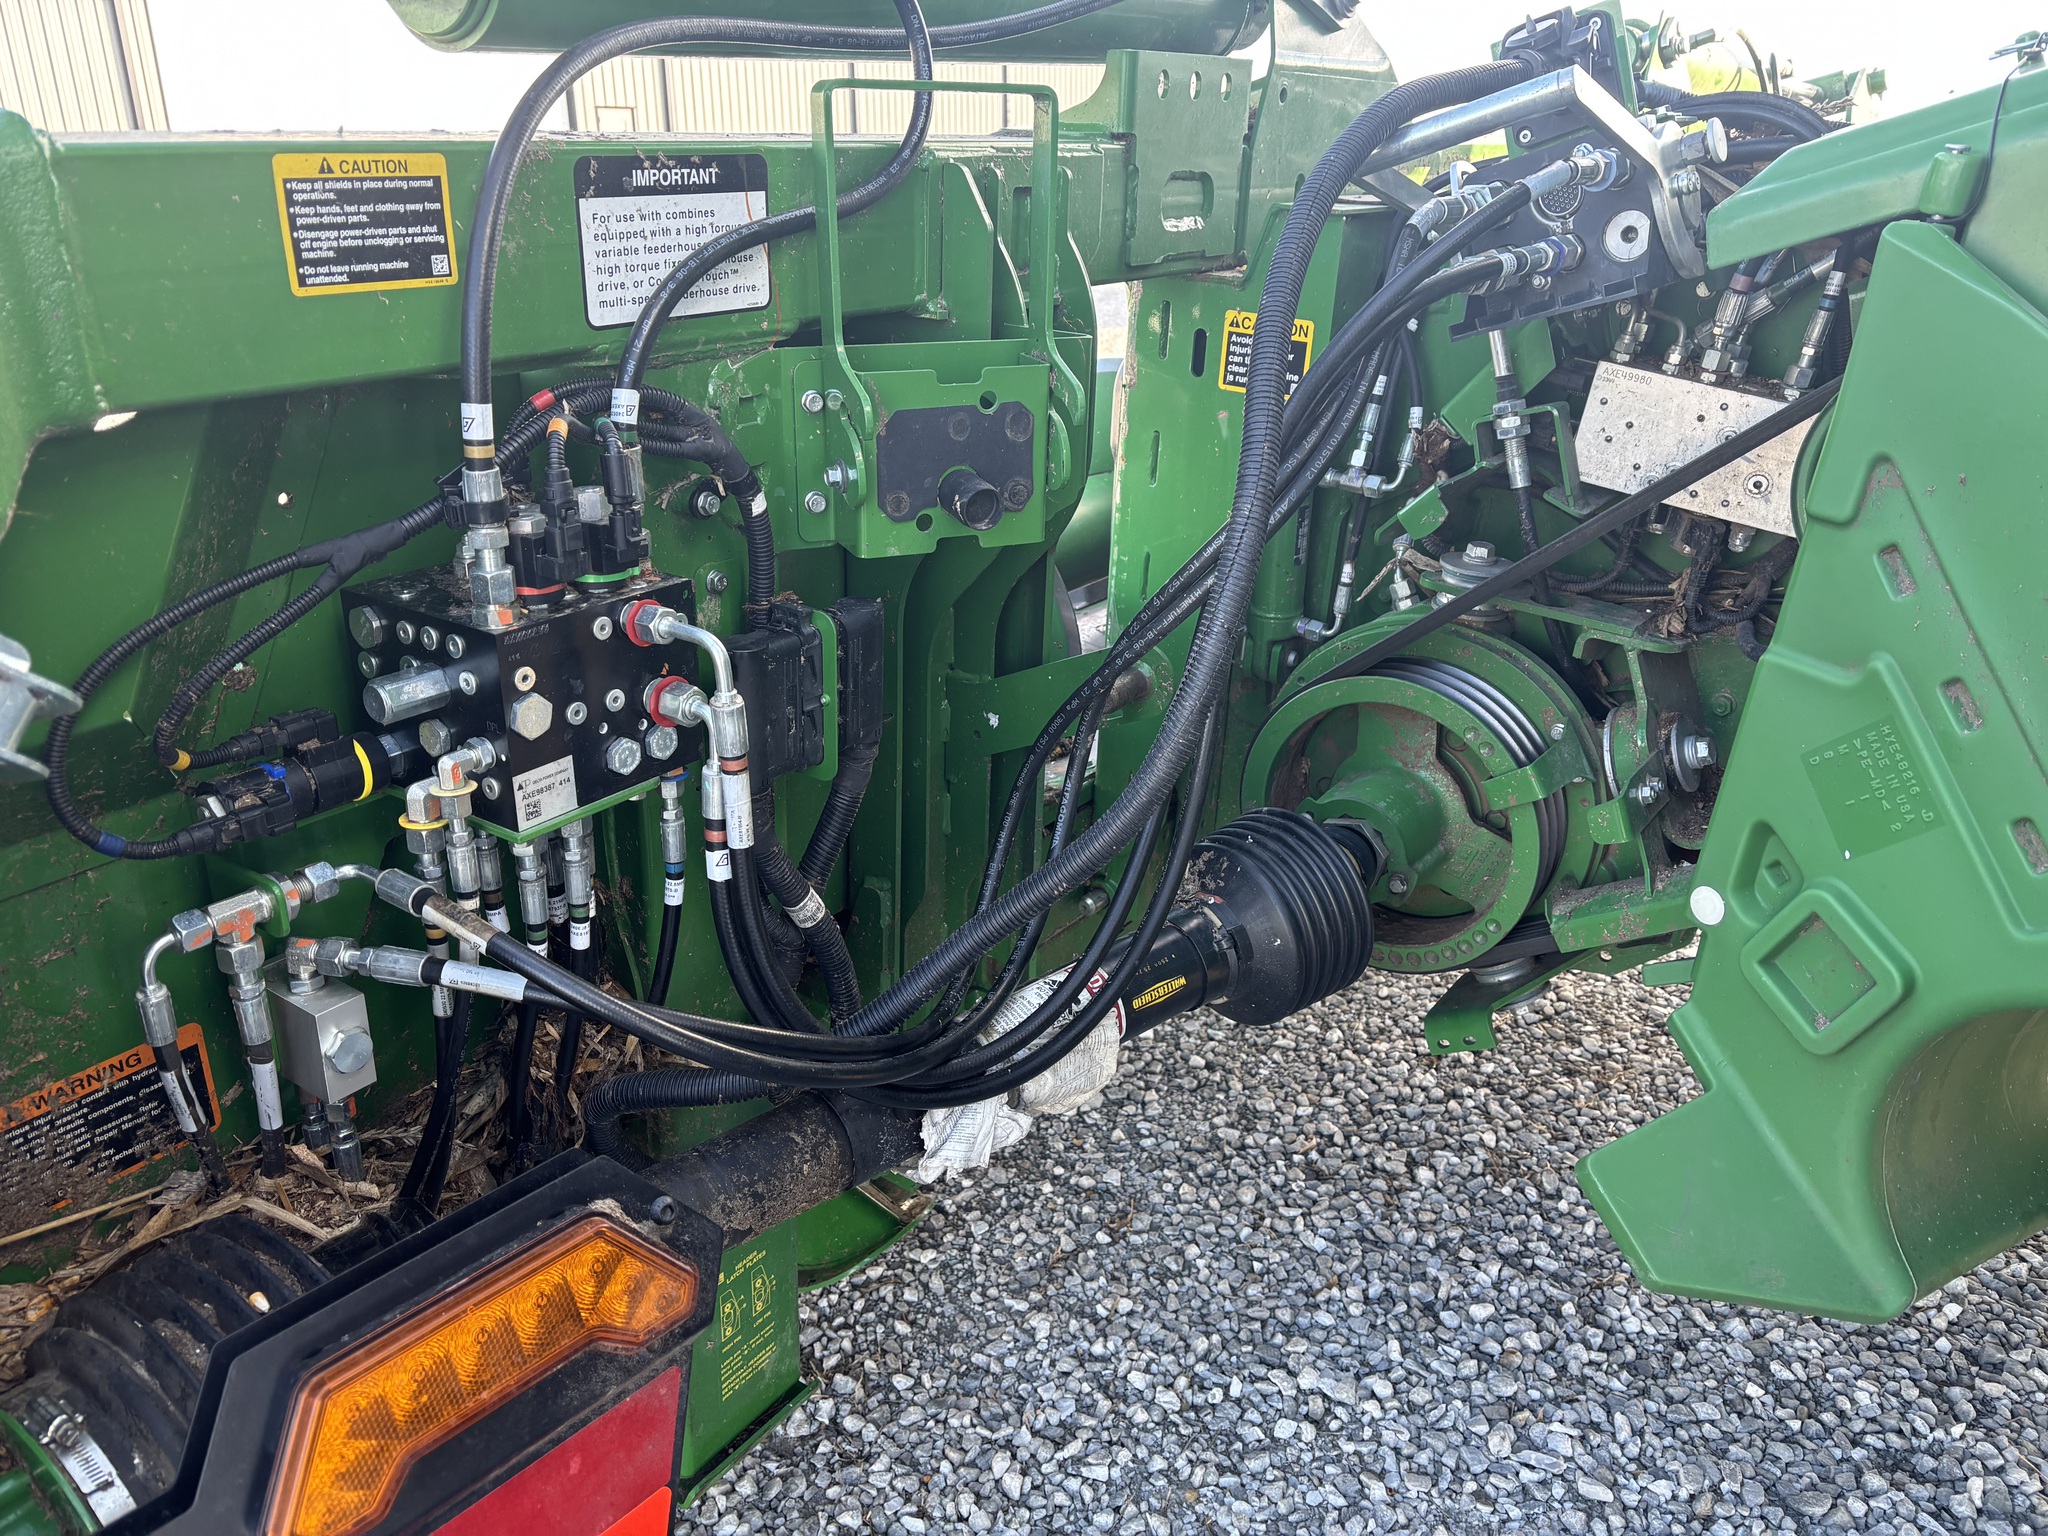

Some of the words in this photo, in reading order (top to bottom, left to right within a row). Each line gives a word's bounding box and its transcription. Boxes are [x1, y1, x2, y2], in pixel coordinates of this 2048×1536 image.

[339, 159, 409, 174] CAUTION
[889, 162, 901, 174] 23
[291, 181, 312, 192] Keep
[313, 180, 324, 190] all
[324, 179, 353, 189] shields
[353, 179, 362, 189] in
[362, 179, 383, 191] place
[384, 179, 408, 190] during
[408, 178, 433, 188] normal
[632, 168, 718, 187] IMPORTANT
[292, 191, 337, 202] operations.
[294, 205, 315, 216] Keep
[316, 204, 343, 214] hands,
[343, 203, 358, 213] feet
[359, 203, 374, 212] and
[374, 202, 405, 214] clothing
[405, 203, 423, 213] away
[424, 201, 441, 210] from
[592, 212, 611, 224] For
[615, 212, 635, 223] use
[639, 209, 662, 222] with
[665, 207, 716, 220] combines
[296, 214, 347, 226] power-driven
[347, 213, 370, 224] parts.
[298, 229, 339, 240] Disengage
[340, 227, 387, 238] power-driven
[388, 226, 407, 237] parts
[407, 226, 421, 235] and
[421, 225, 438, 233] shut
[593, 229, 645, 243] equipped
[649, 223, 672, 238] with
[675, 227, 681, 236] a
[685, 223, 707, 237] high
[300, 239, 311, 249] off
[311, 238, 338, 249] engine
[339, 237, 363, 247] before
[364, 236, 404, 247] unclogging
[405, 236, 413, 244] or
[413, 234, 445, 245] servicing
[301, 248, 337, 259] machine.
[594, 243, 640, 259] variable
[304, 266, 316, 275] Do
[316, 265, 329, 274] not
[330, 263, 350, 274] leave
[350, 262, 379, 274] running
[380, 260, 409, 270] machine
[596, 264, 621, 277] high
[625, 261, 660, 275] torque
[305, 274, 350, 285] unattended.
[597, 278, 629, 293] drive,
[633, 279, 644, 288] or
[732, 283, 761, 295] drive.
[633, 339, 644, 354] 21
[1228, 354, 1243, 363] can
[624, 359, 637, 382] MPa
[1227, 364, 1248, 373] clear
[1602, 366, 1653, 386] AXE49980
[1226, 373, 1234, 382] is
[1129, 624, 1141, 636] 22
[1880, 724, 1921, 795] HXE48216
[1016, 753, 1035, 787] exceeds
[1866, 731, 1891, 769] MADE
[1885, 773, 1901, 789] IN
[1896, 794, 1916, 823] USA
[521, 782, 556, 802] AXE98387
[558, 776, 571, 787] 414
[1008, 790, 1020, 808] SAE
[1049, 780, 1073, 851] ALFAGOMMA
[987, 862, 997, 876] EN
[1132, 974, 1188, 1011] WALTERSCHEID
[31, 1051, 142, 1112] WARNING
[113, 1078, 130, 1091] with
[87, 1095, 137, 1120] components,
[75, 1140, 92, 1153] and
[93, 1128, 119, 1144] Repair
[726, 1267, 745, 1285] LATCH
[745, 1250, 767, 1268] PLATES
[735, 1250, 758, 1271] HEADER
